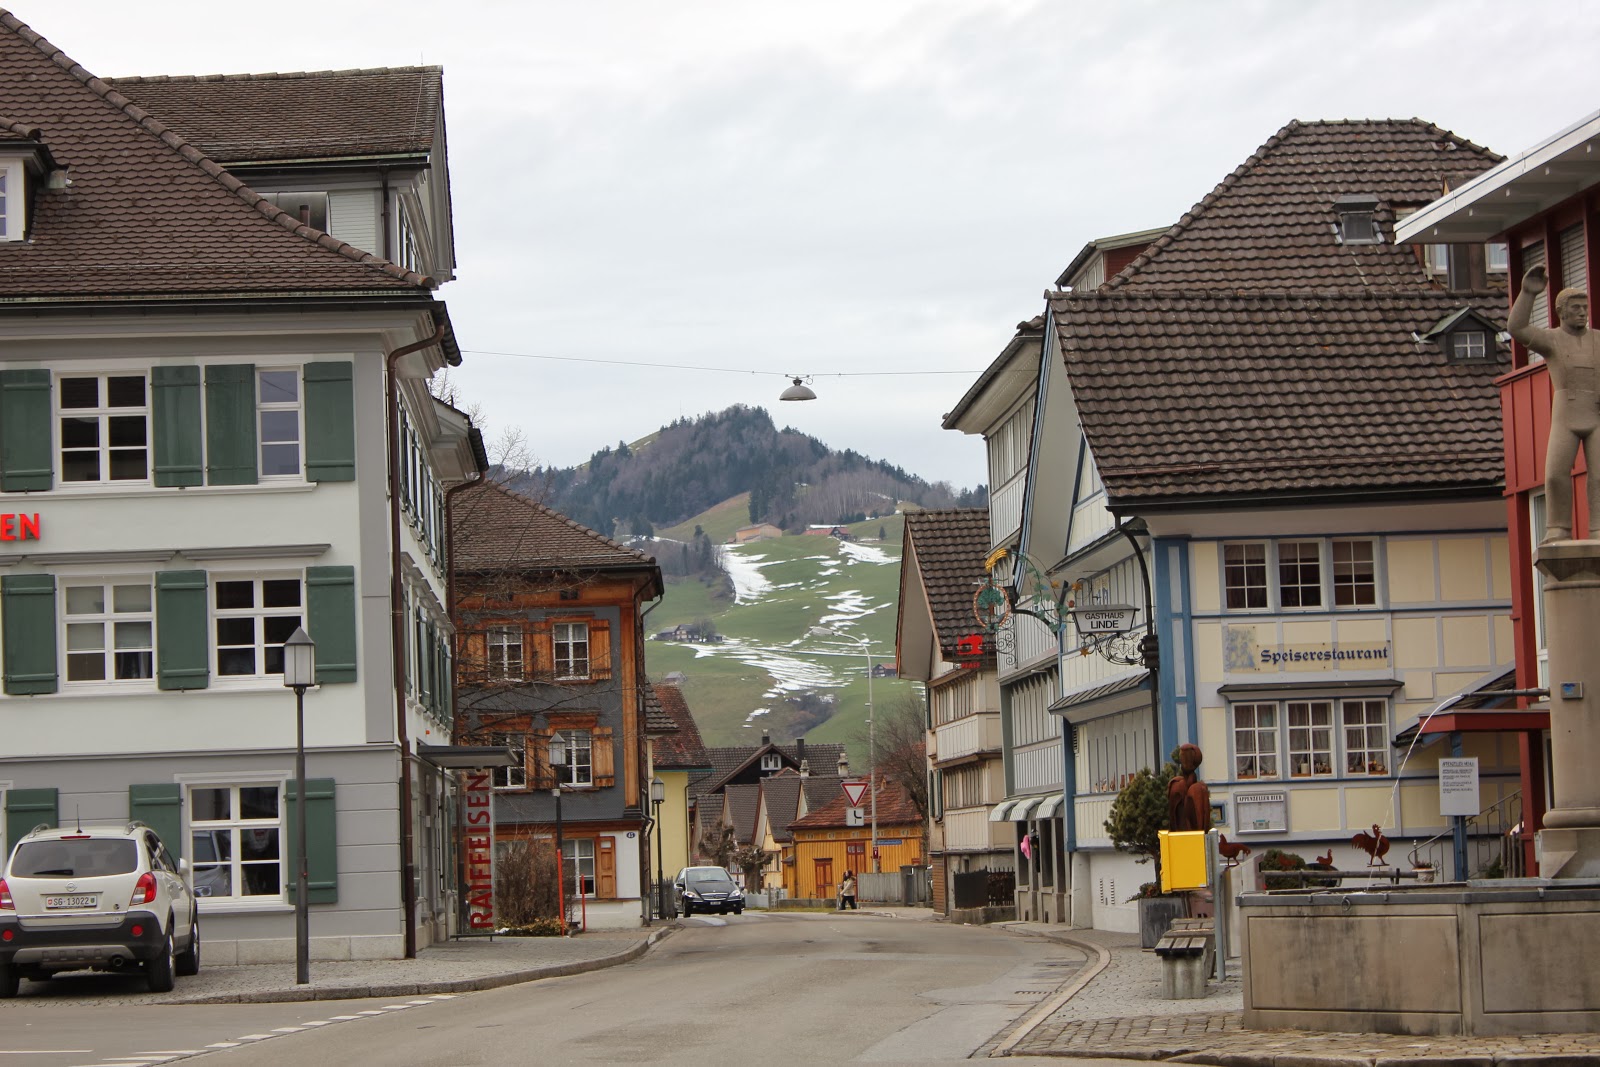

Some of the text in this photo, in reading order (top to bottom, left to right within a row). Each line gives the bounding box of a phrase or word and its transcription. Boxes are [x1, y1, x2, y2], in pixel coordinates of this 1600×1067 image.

[0, 513, 40, 541] EN
[1090, 620, 1119, 629] LINDE
[1260, 647, 1388, 665] Speiserestaurant
[467, 774, 493, 928] RAIFFEISEN
